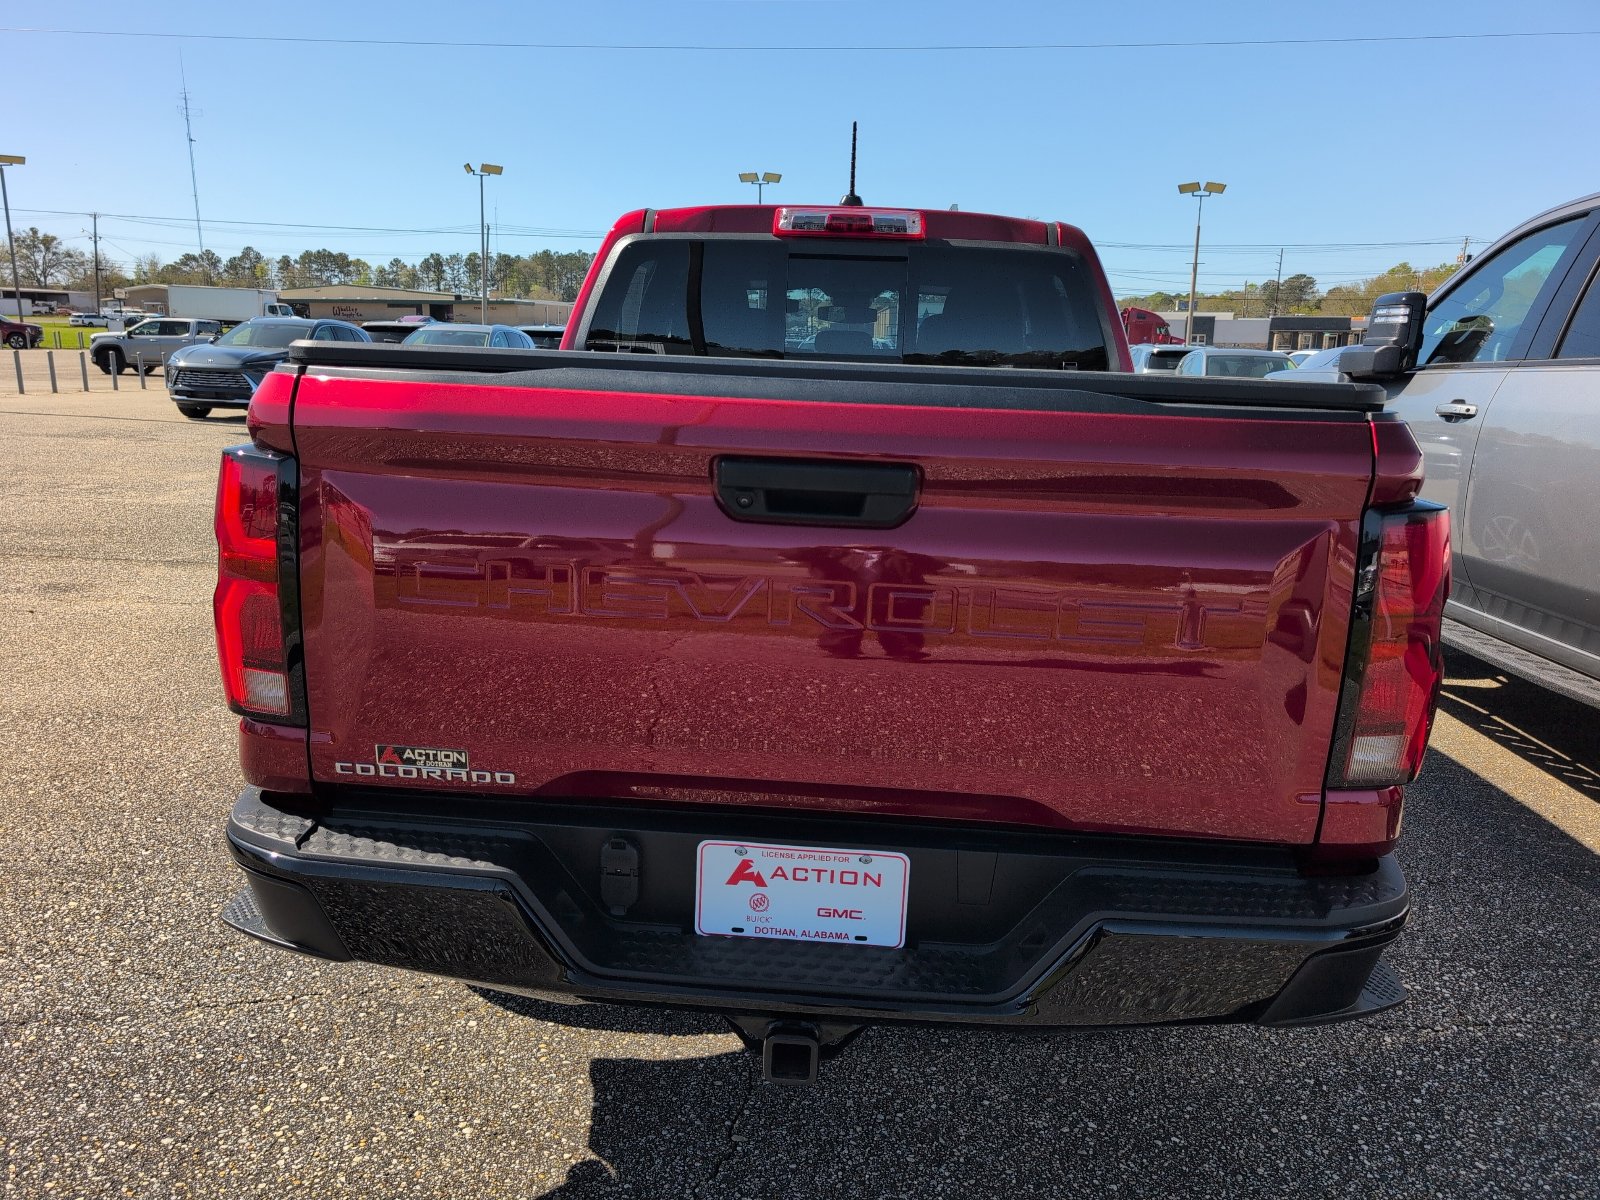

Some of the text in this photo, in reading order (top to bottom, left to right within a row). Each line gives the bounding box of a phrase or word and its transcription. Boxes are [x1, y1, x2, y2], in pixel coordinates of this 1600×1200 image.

[397, 554, 1243, 648] CHEVROLET
[403, 748, 466, 763] ACTION
[335, 762, 516, 784] COLORADO
[761, 850, 795, 860] LICENSE
[797, 853, 832, 862] APPLIED
[770, 865, 882, 887] ACTION
[746, 915, 771, 923] BUICK
[754, 926, 850, 941] DOTHAN, ALABAMA
